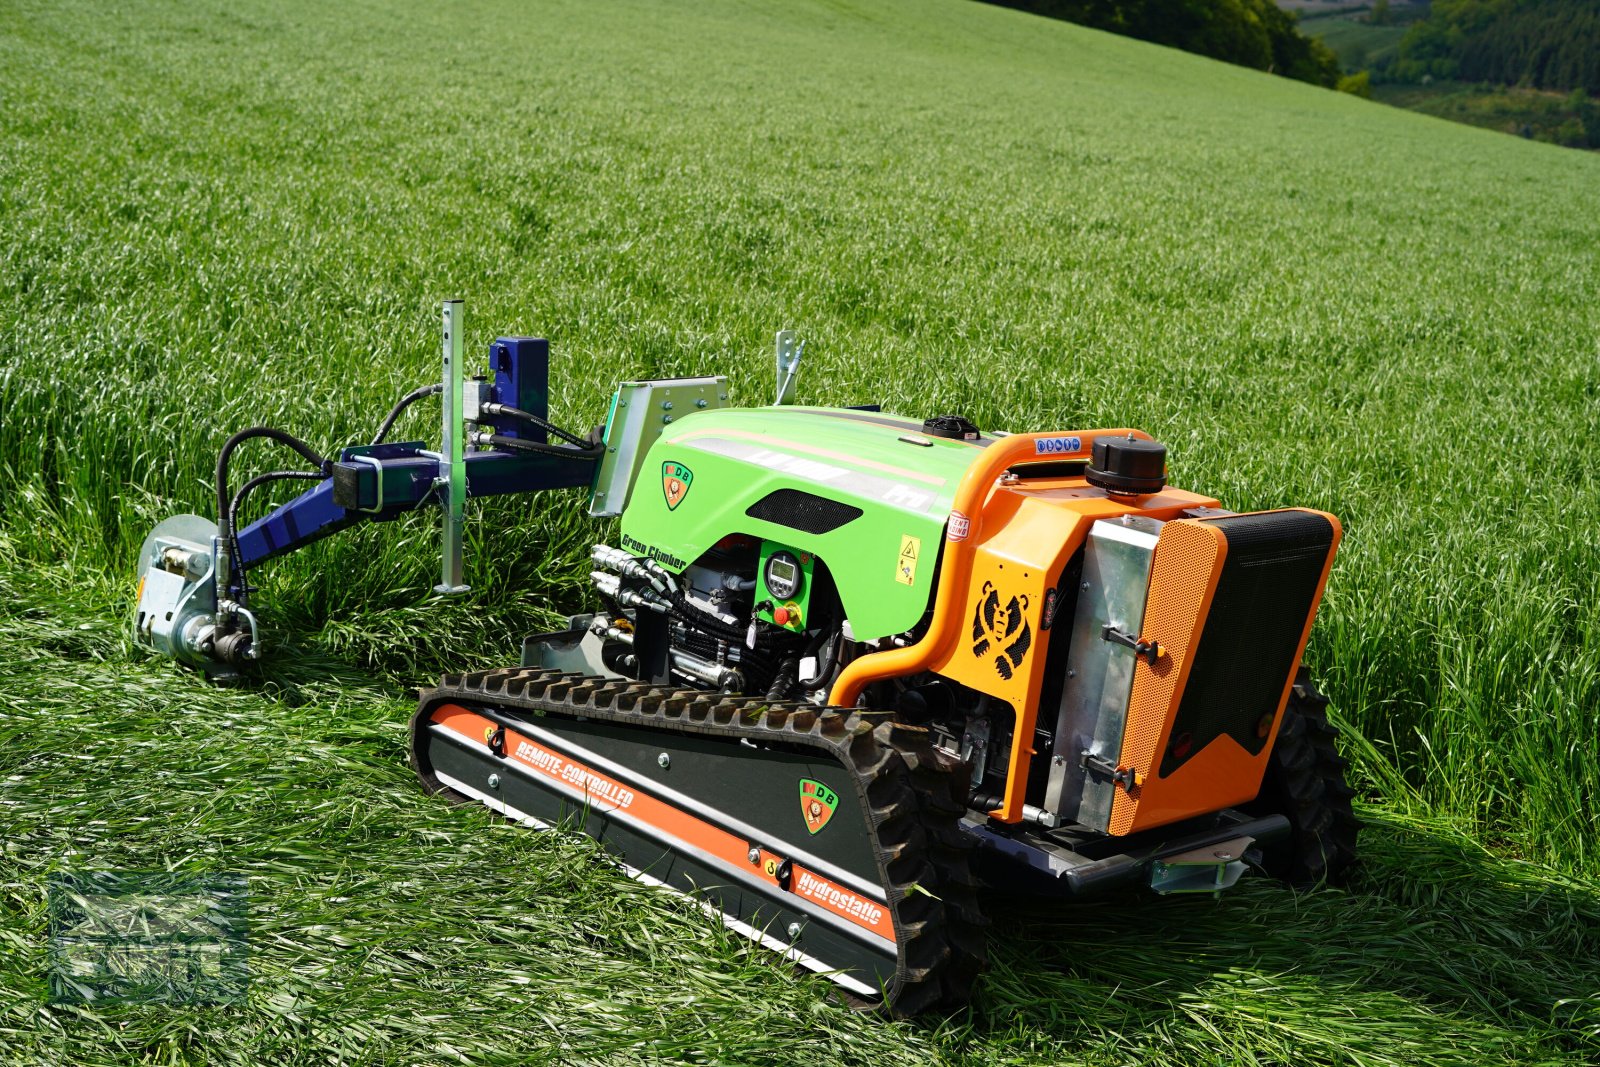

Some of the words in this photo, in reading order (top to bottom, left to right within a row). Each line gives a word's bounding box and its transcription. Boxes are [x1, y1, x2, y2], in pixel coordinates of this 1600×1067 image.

[665, 464, 690, 482] MDB
[621, 533, 648, 555] Green
[647, 545, 687, 570] Climber
[514, 740, 635, 809] REMOTE-CONTROLLED
[802, 781, 835, 805] MDB
[796, 871, 883, 926] Hydrostatic
